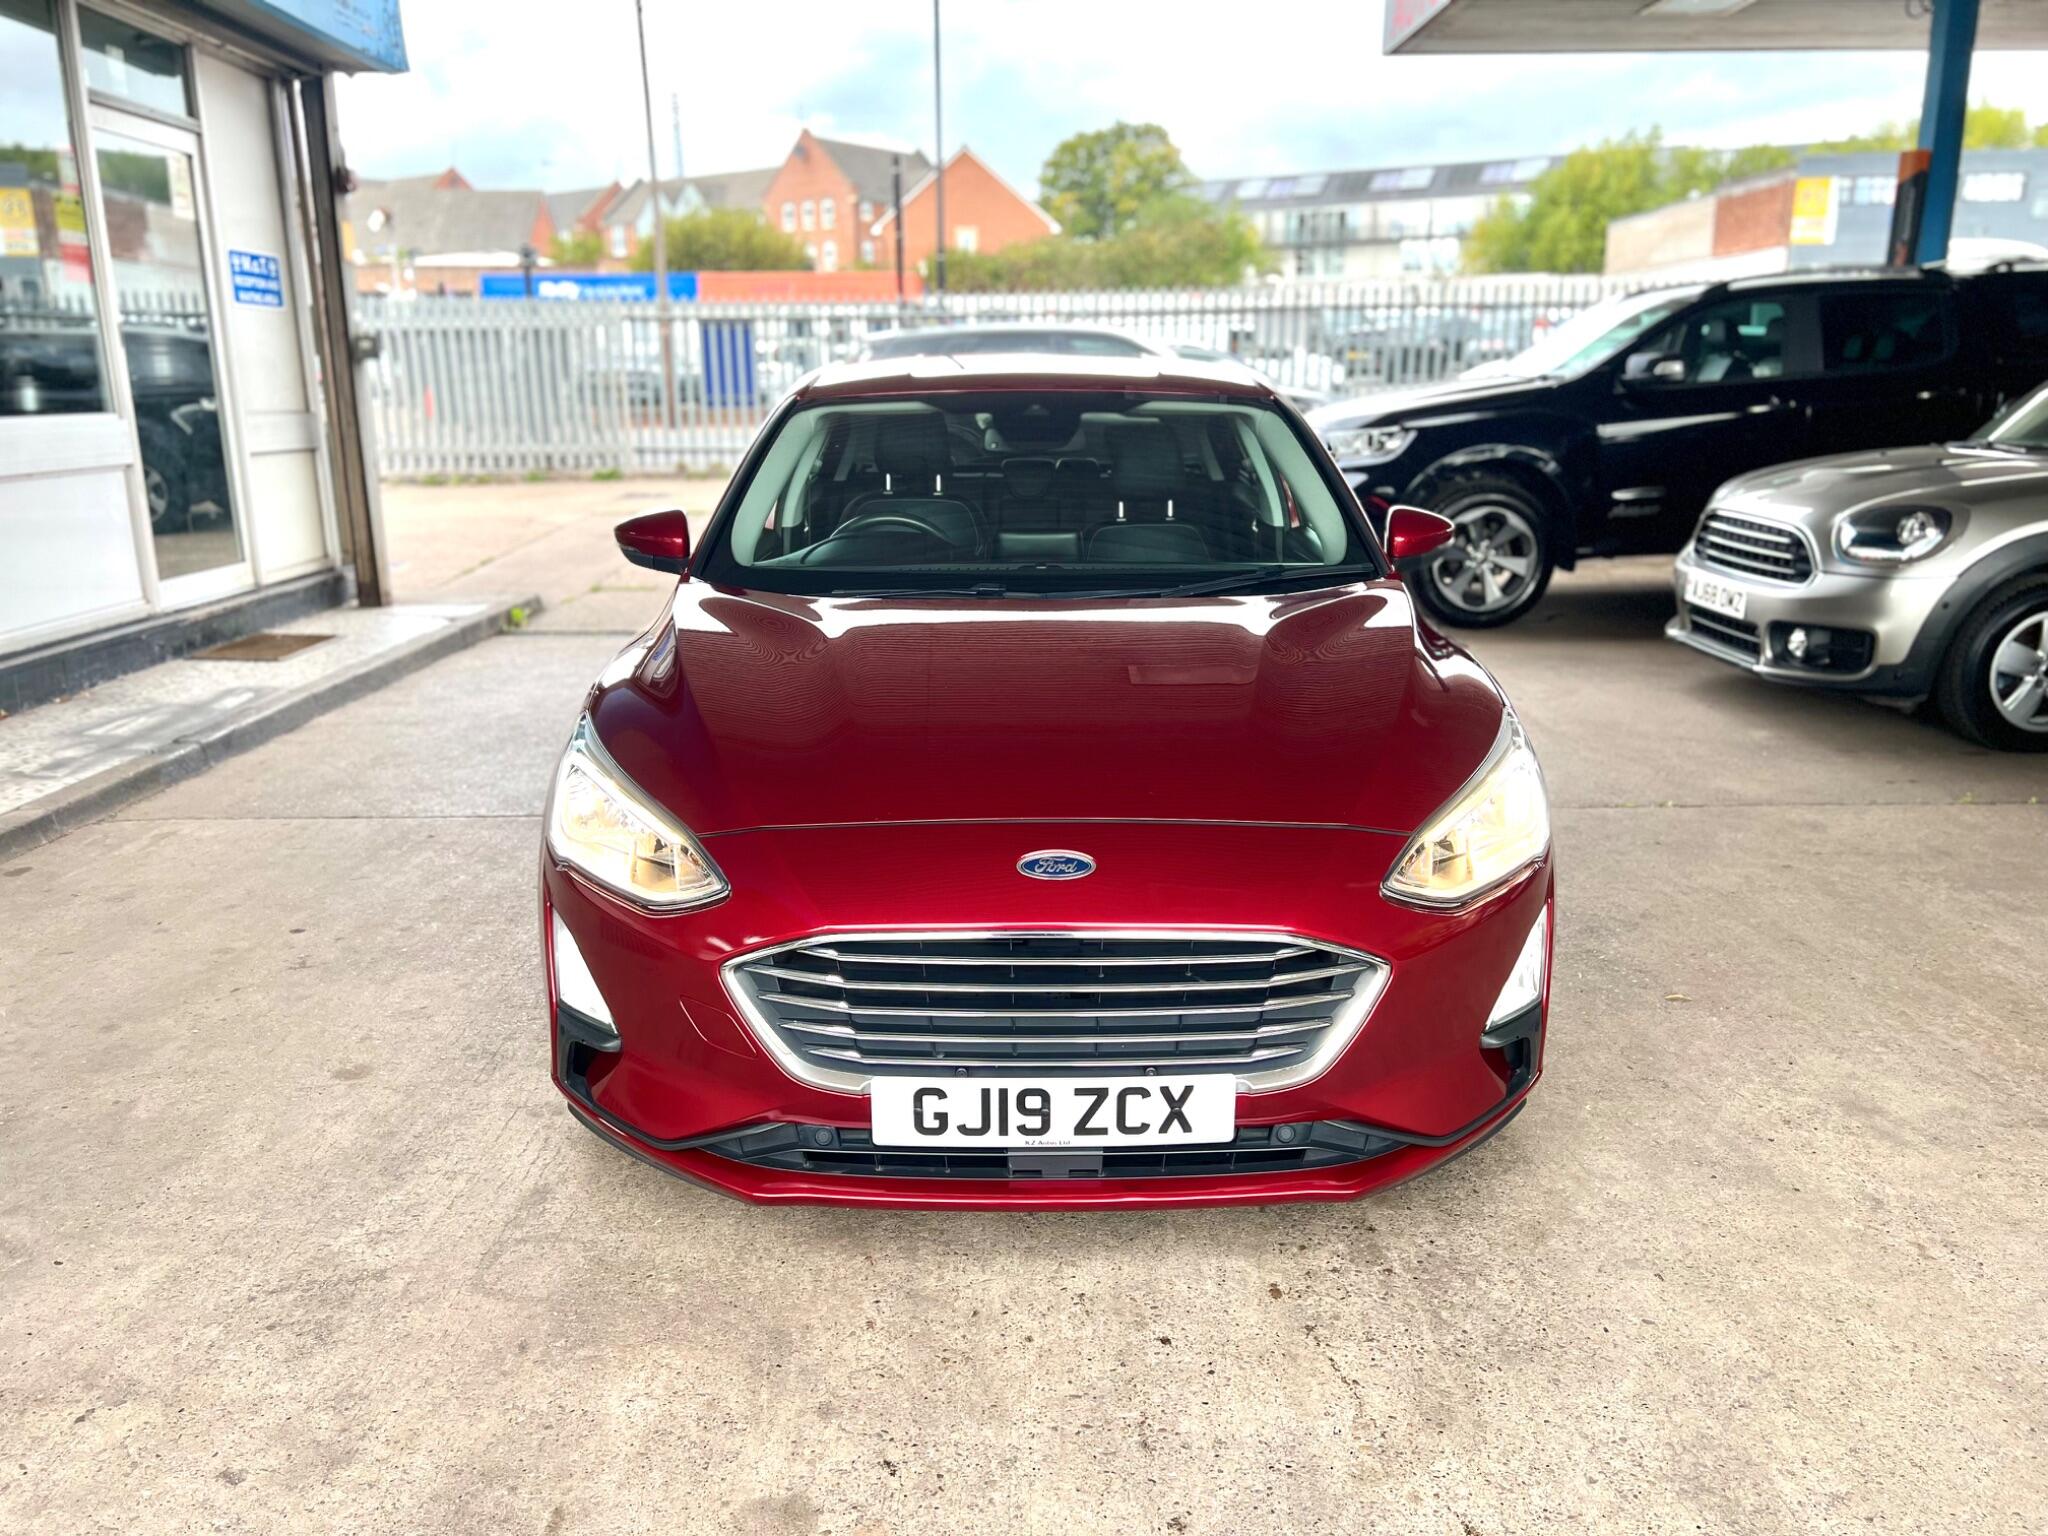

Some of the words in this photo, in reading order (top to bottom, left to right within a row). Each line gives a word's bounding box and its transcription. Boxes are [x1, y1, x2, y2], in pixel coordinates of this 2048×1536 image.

[1034, 857, 1078, 873] Ford
[913, 1087, 1051, 1137] GJ19
[1073, 1085, 1194, 1136] ZCX
